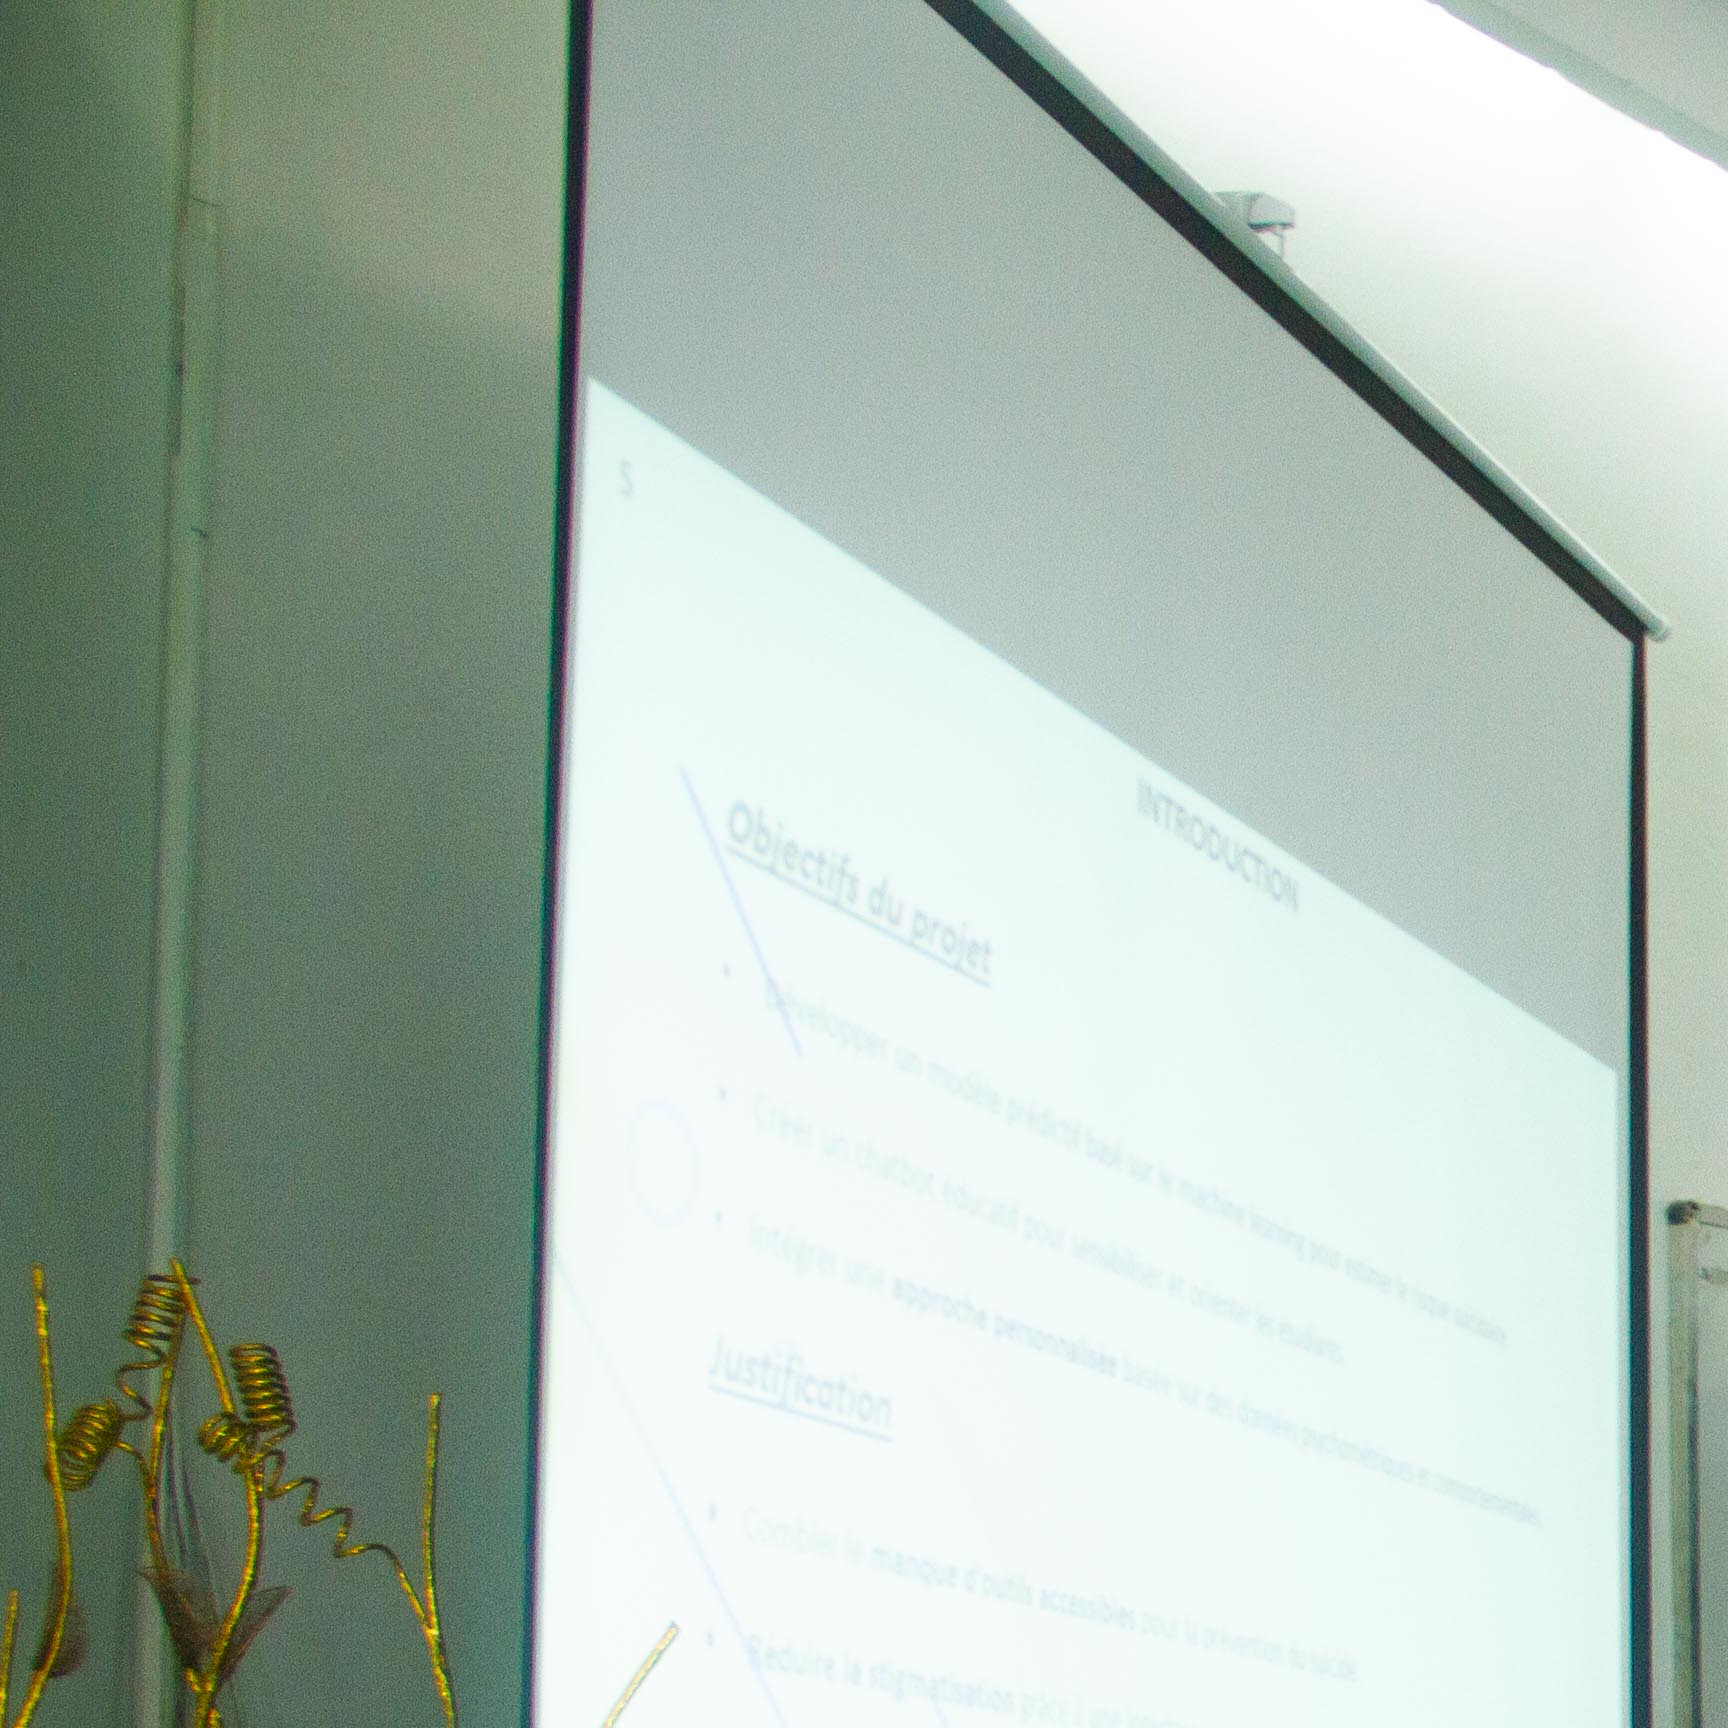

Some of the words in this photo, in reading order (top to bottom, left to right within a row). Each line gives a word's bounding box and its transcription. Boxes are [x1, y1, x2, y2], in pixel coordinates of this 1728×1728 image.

[727, 800, 860, 917] Objectifs
[867, 879, 903, 927] du
[908, 909, 992, 986] projet
[1137, 784, 1299, 911] INTRODUCTION
[752, 1092, 814, 1145] Créer
[820, 1132, 849, 1161] un
[855, 1140, 935, 1196] chatbot
[1022, 1213, 1066, 1251] pour
[895, 1047, 923, 1076] un
[928, 1060, 1002, 1115] modèle
[1006, 1097, 1082, 1149] prédictif
[1085, 1129, 1123, 1170] basé
[1126, 1153, 1155, 1184] sur
[844, 1261, 887, 1295] une
[891, 1276, 988, 1331] approche
[994, 1315, 1118, 1377] personnalisée
[709, 1338, 892, 1443] Justification
[743, 1506, 838, 1557] Combler
[845, 1533, 866, 1566] le
[872, 1545, 959, 1588] manque
[964, 1564, 1034, 1607] d'outils
[1038, 1587, 1136, 1630] accessibles
[746, 1632, 836, 1681] Réduire
[843, 1651, 863, 1687] la
[869, 1663, 1015, 1713] stigmatisation
